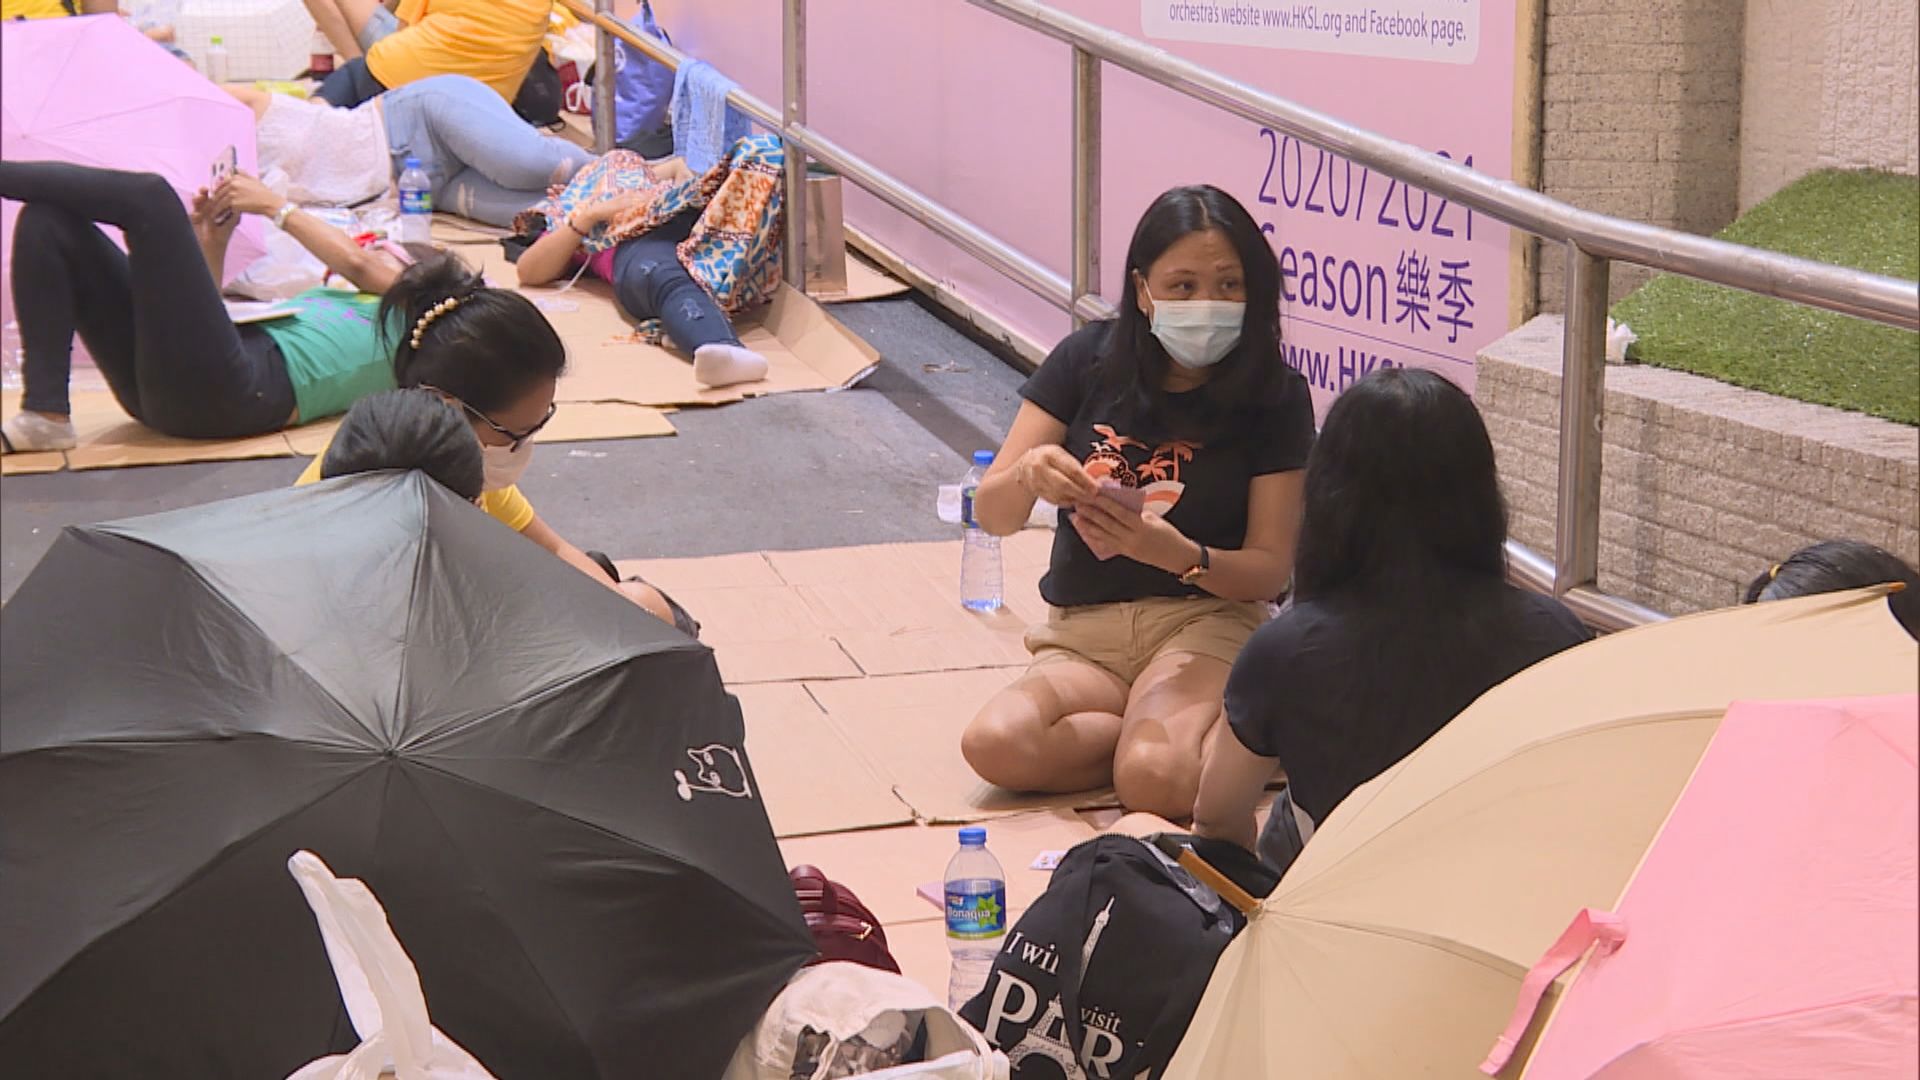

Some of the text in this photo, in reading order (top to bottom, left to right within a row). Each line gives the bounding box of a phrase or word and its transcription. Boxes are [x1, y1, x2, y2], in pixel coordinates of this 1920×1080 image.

[1169, 0, 1467, 47] orchestra's website www.HKSL.org and Facebook page.
[1260, 222, 1387, 325] eason
[1006, 931, 1060, 975] I wil
[984, 969, 1151, 1080] PAR
[1081, 1006, 1121, 1033] visit
